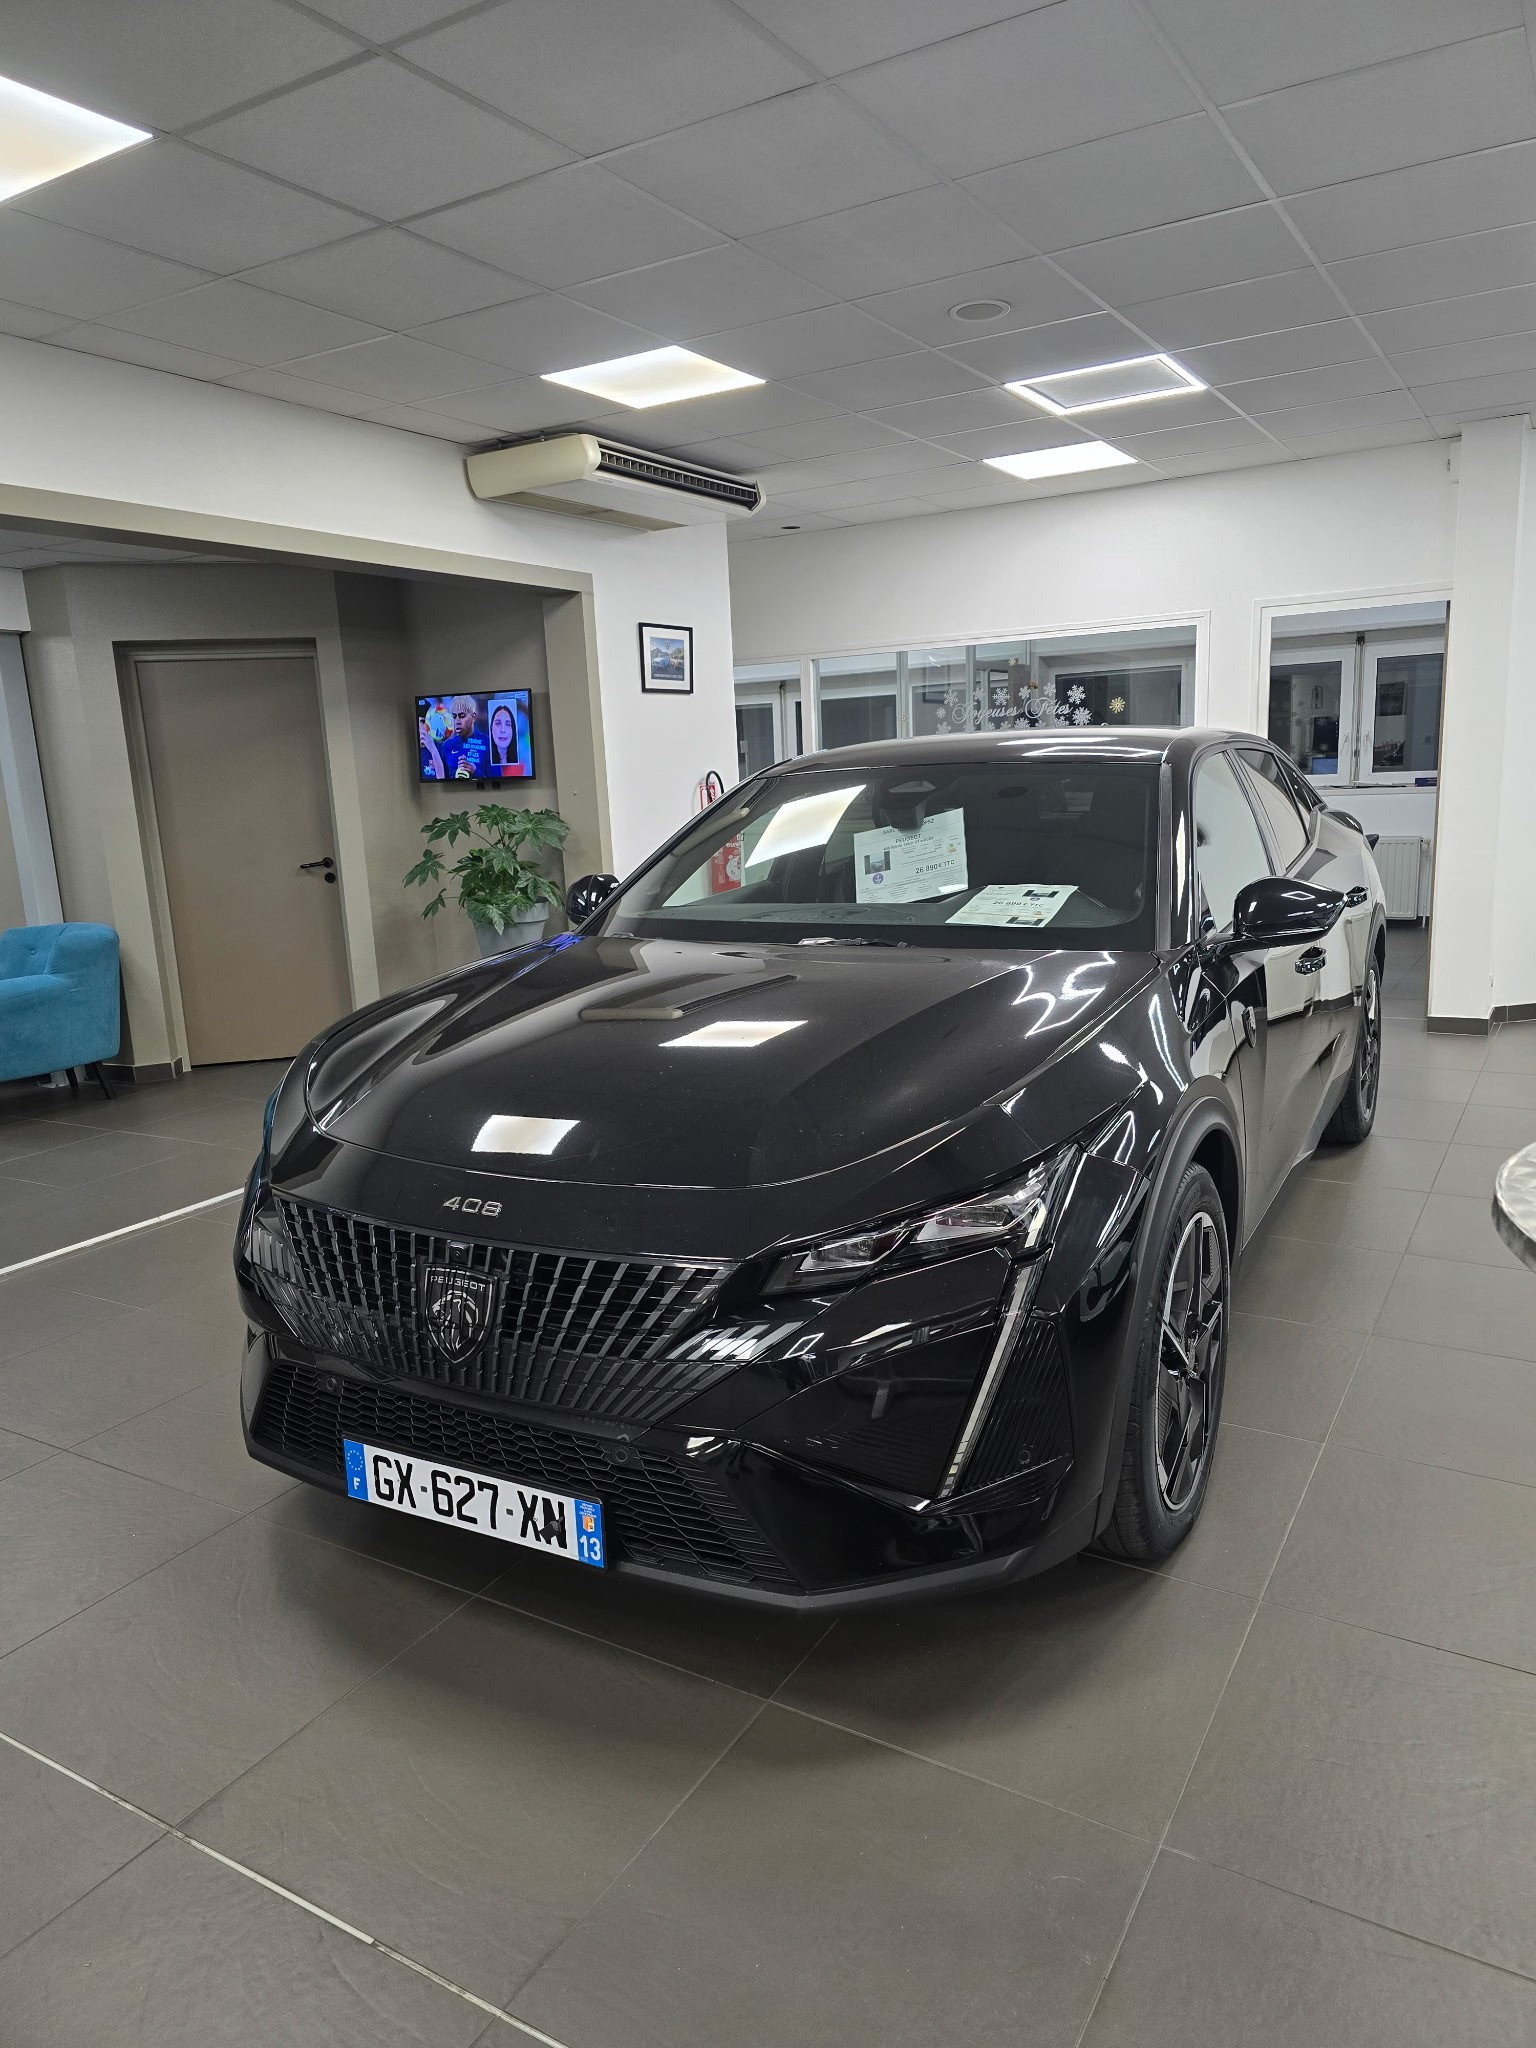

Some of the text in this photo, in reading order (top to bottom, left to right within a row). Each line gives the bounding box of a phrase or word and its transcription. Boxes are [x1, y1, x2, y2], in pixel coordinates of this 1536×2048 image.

[951, 701, 1020, 724] Joyeuses
[895, 833, 921, 843] PEUGEOT
[915, 866, 924, 874] 26
[925, 863, 938, 872] 890
[442, 1196, 503, 1217] 408
[430, 1275, 486, 1292] PEUGEOT
[353, 1454, 568, 1550] F GX-627-XN
[579, 1534, 601, 1561] 13
